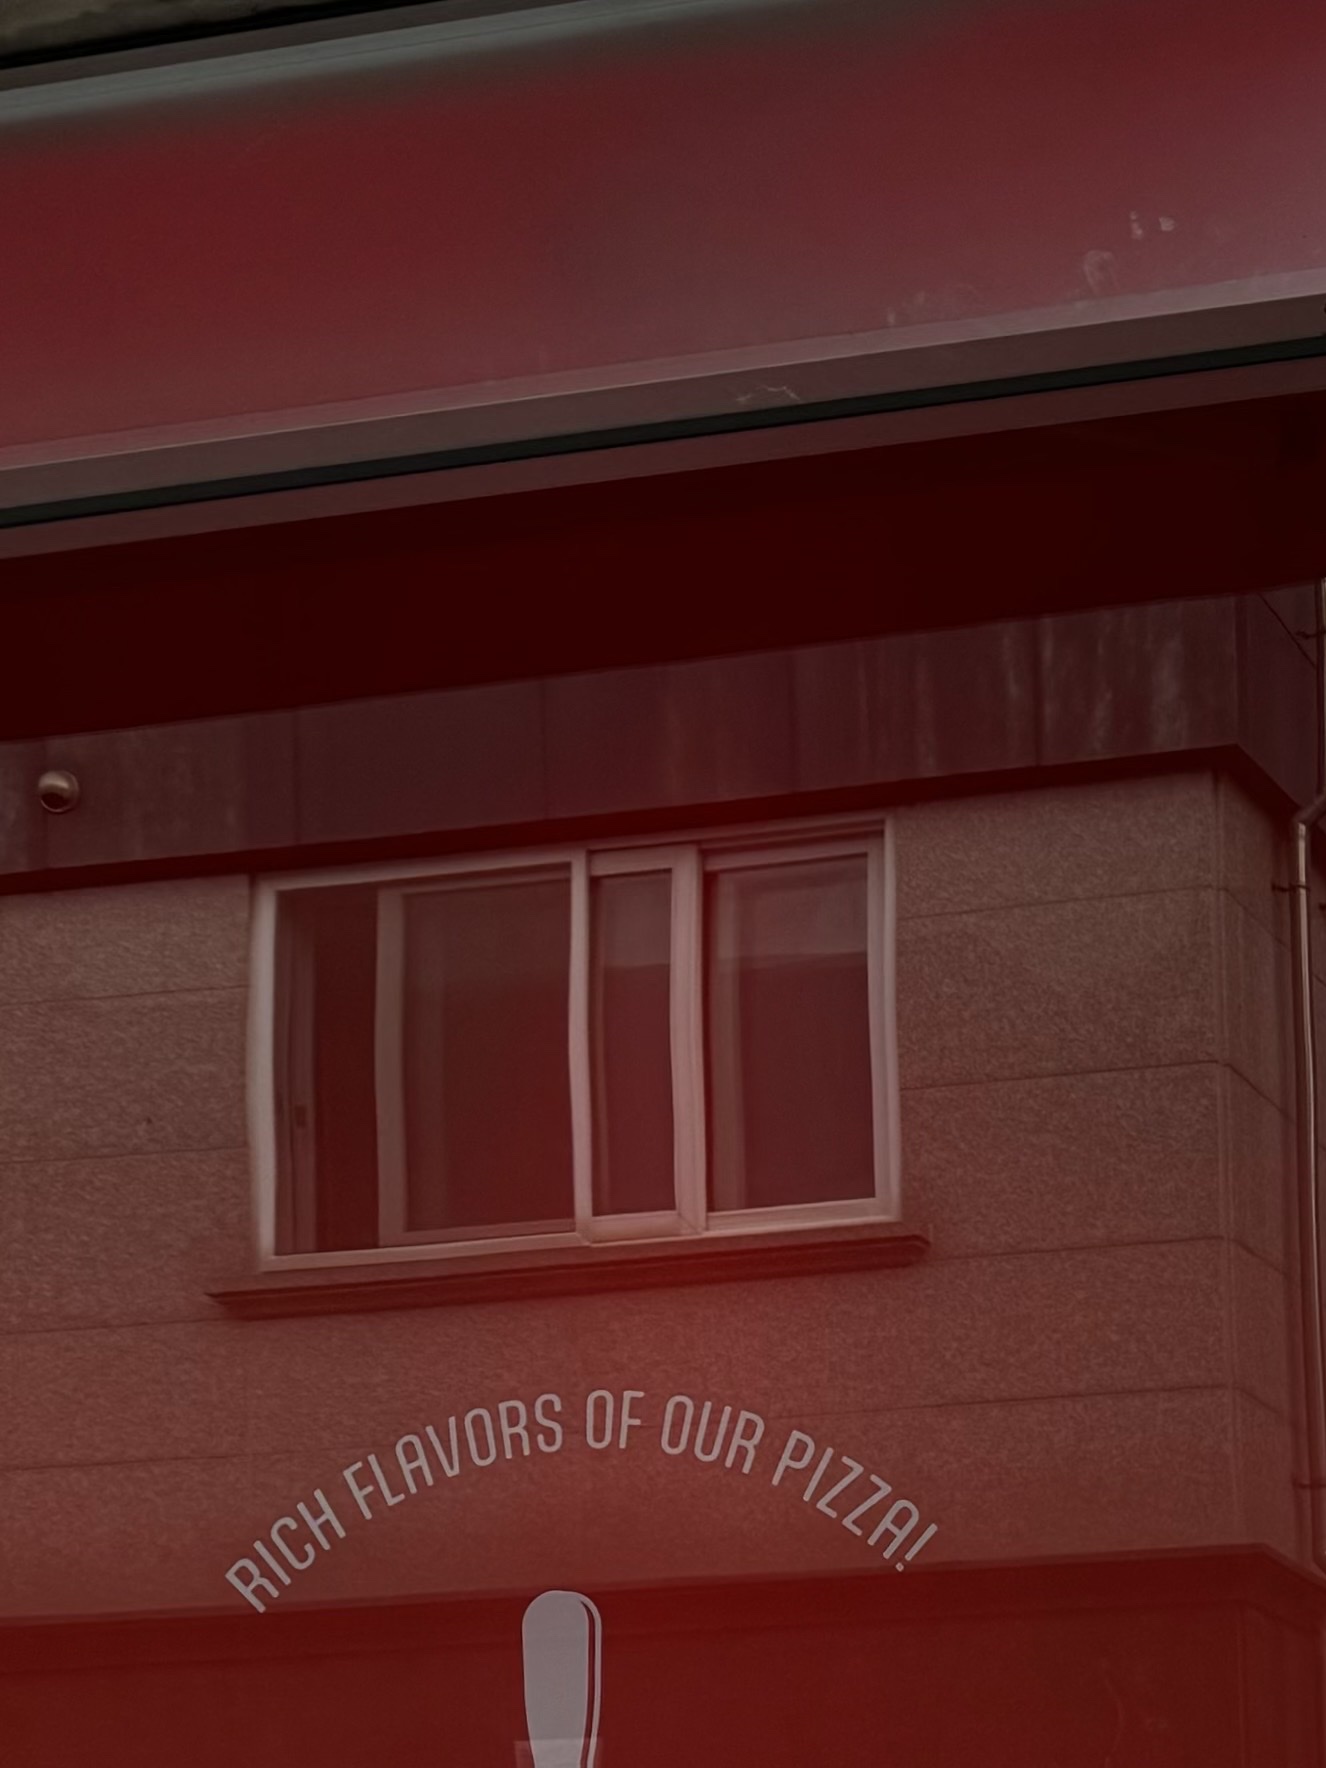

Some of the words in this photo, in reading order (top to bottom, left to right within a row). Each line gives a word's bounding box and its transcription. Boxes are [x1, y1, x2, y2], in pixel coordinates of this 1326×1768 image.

[225, 1489, 346, 1613] RICH
[343, 1394, 563, 1520] FLAVORS
[586, 1390, 645, 1449] OF
[661, 1395, 765, 1474] OUR
[772, 1430, 938, 1571] PIZZA!
